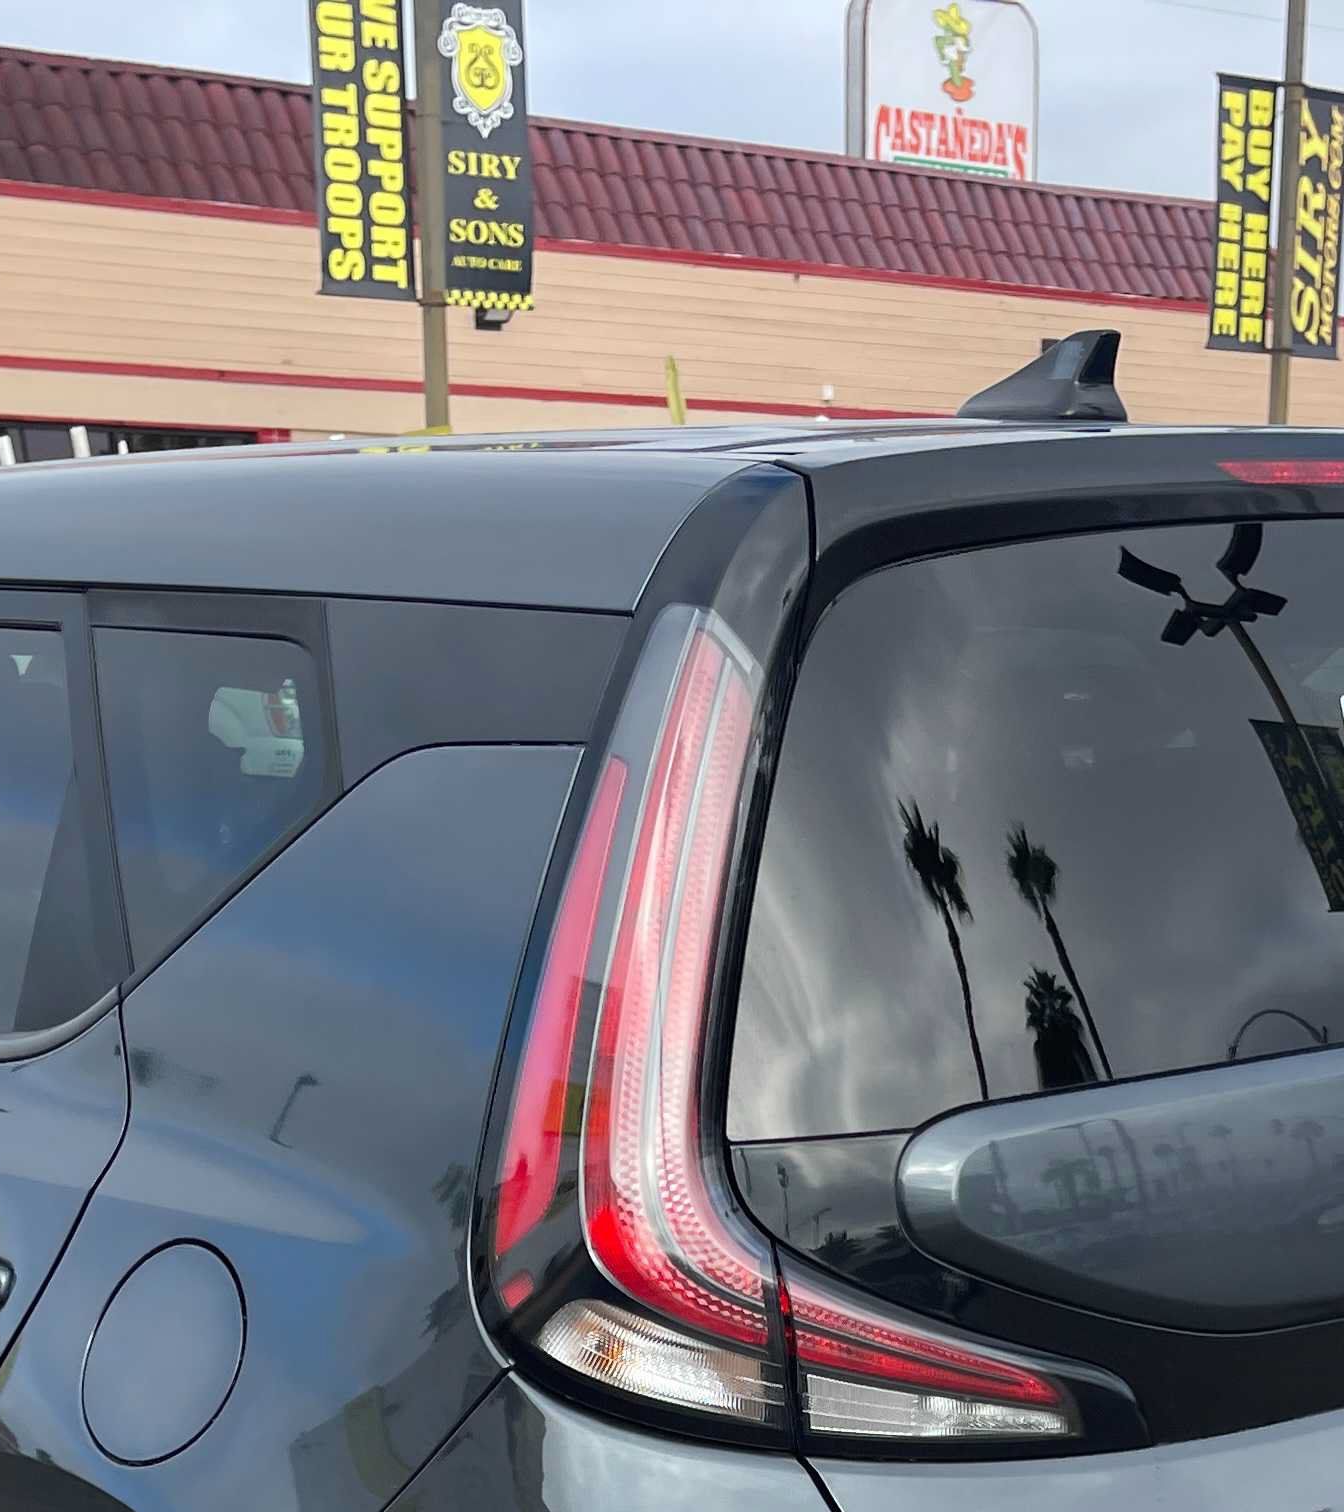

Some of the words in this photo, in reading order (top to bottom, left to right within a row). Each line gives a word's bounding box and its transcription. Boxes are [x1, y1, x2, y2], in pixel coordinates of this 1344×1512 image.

[315, 0, 355, 72] UR
[321, 83, 366, 281] TROOPS
[363, 59, 408, 289] SUPPORT
[447, 150, 521, 180] SIRY
[1221, 91, 1247, 192] PAY
[1246, 89, 1275, 201] BUY
[449, 218, 525, 248] SONS
[473, 188, 500, 210] &
[1290, 97, 1329, 346] SIRY
[451, 255, 486, 270] AUTO
[1213, 202, 1242, 336] HERE
[1239, 212, 1267, 343] HERE
